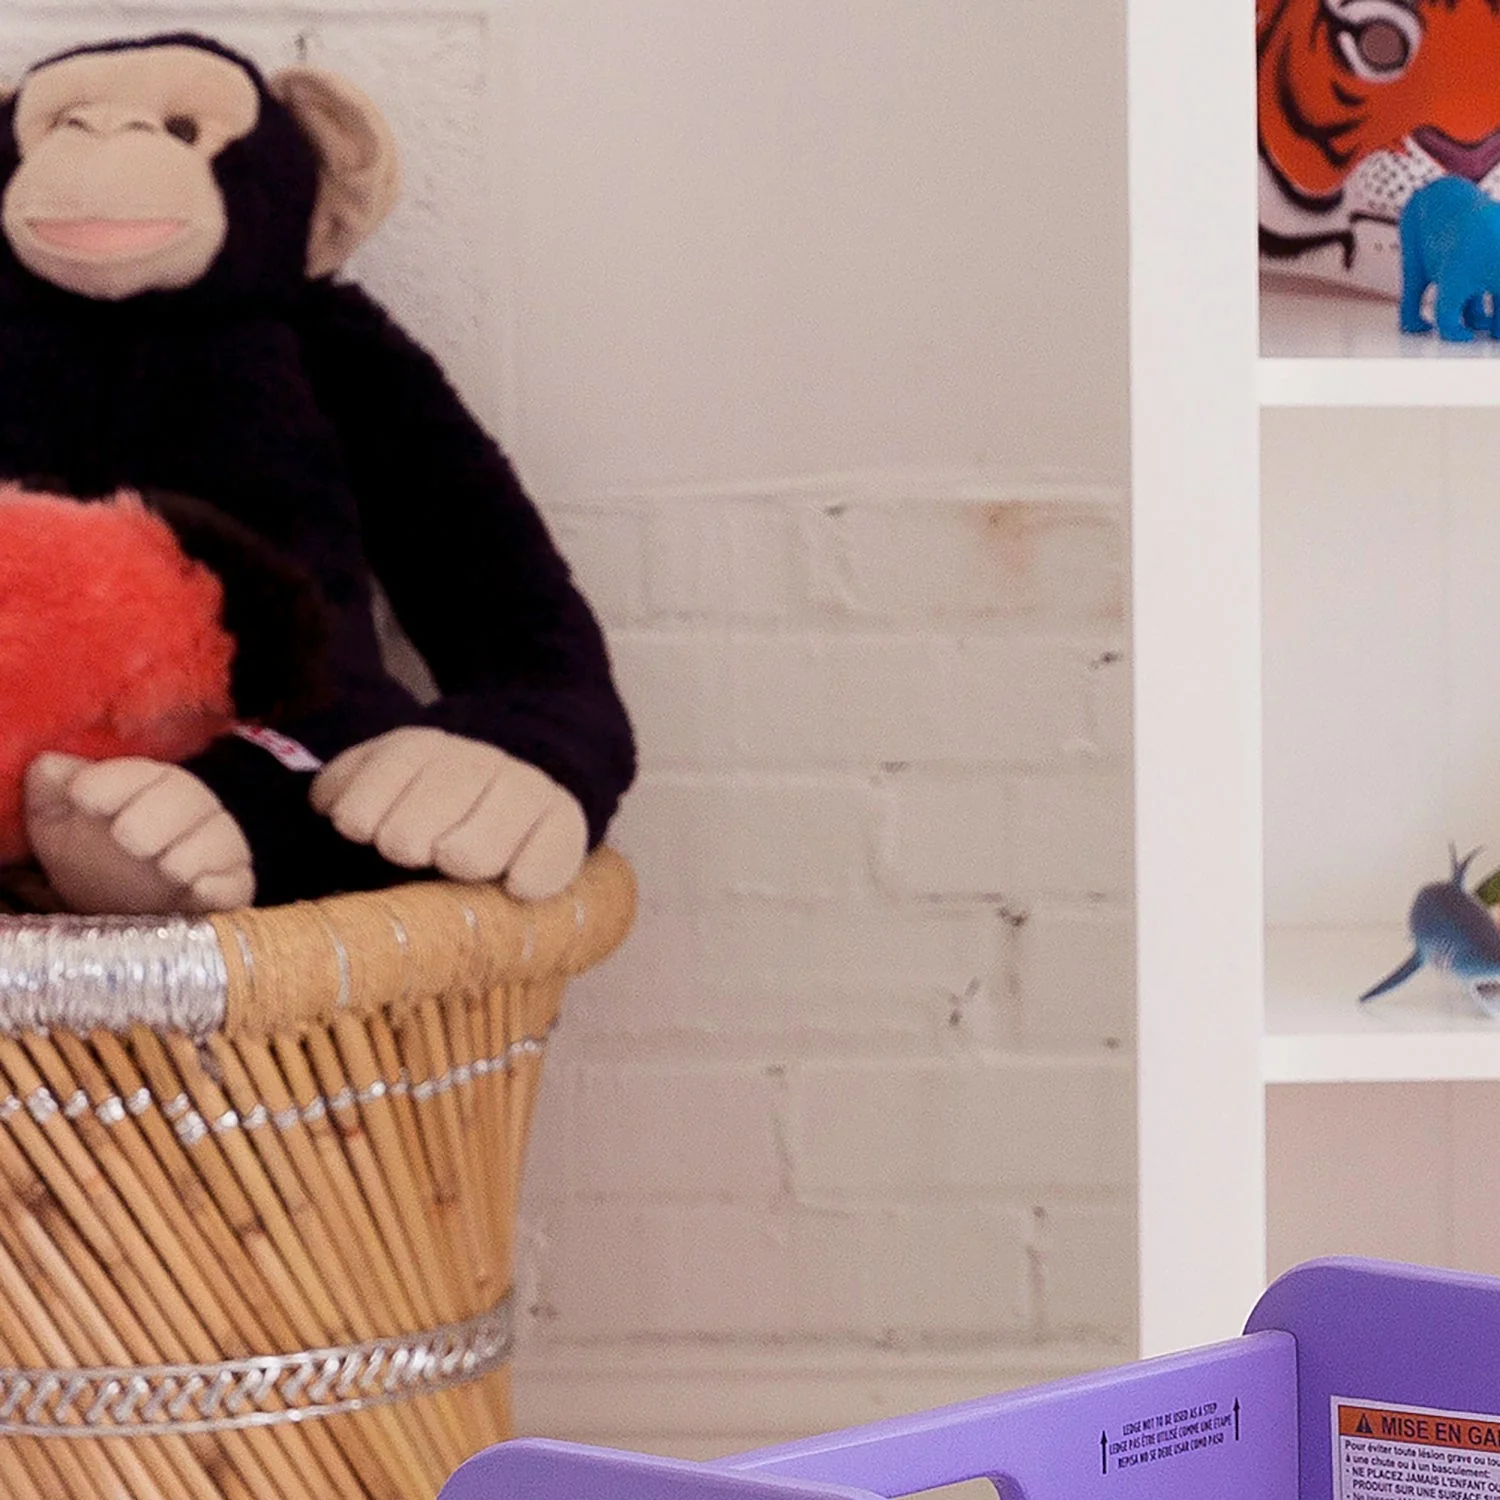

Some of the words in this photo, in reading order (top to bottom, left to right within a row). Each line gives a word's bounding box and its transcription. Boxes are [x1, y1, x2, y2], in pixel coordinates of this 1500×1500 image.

[1381, 1416, 1428, 1439] MISE
[1435, 1422, 1461, 1443] EN
[1345, 1439, 1366, 1451] Pour
[1367, 1443, 1392, 1454] éviter
[1393, 1446, 1416, 1457] toute
[1418, 1448, 1445, 1460] lésion
[1447, 1453, 1471, 1463] grave
[1473, 1456, 1485, 1465] ou
[1345, 1454, 1350, 1462] à
[1352, 1456, 1369, 1464] une
[1371, 1456, 1395, 1467] chute
[1397, 1461, 1409, 1469] ou
[1411, 1460, 1416, 1470] à
[1418, 1463, 1430, 1471] un
[1352, 1466, 1364, 1477] NE
[1367, 1468, 1402, 1481] PLACEZ
[1405, 1473, 1439, 1485] JAMAIS
[1441, 1477, 1485, 1490] L'ENFANT
[1352, 1479, 1392, 1492] PRODUIT
[1395, 1484, 1414, 1495] SUR
[1416, 1487, 1435, 1498] UNE
